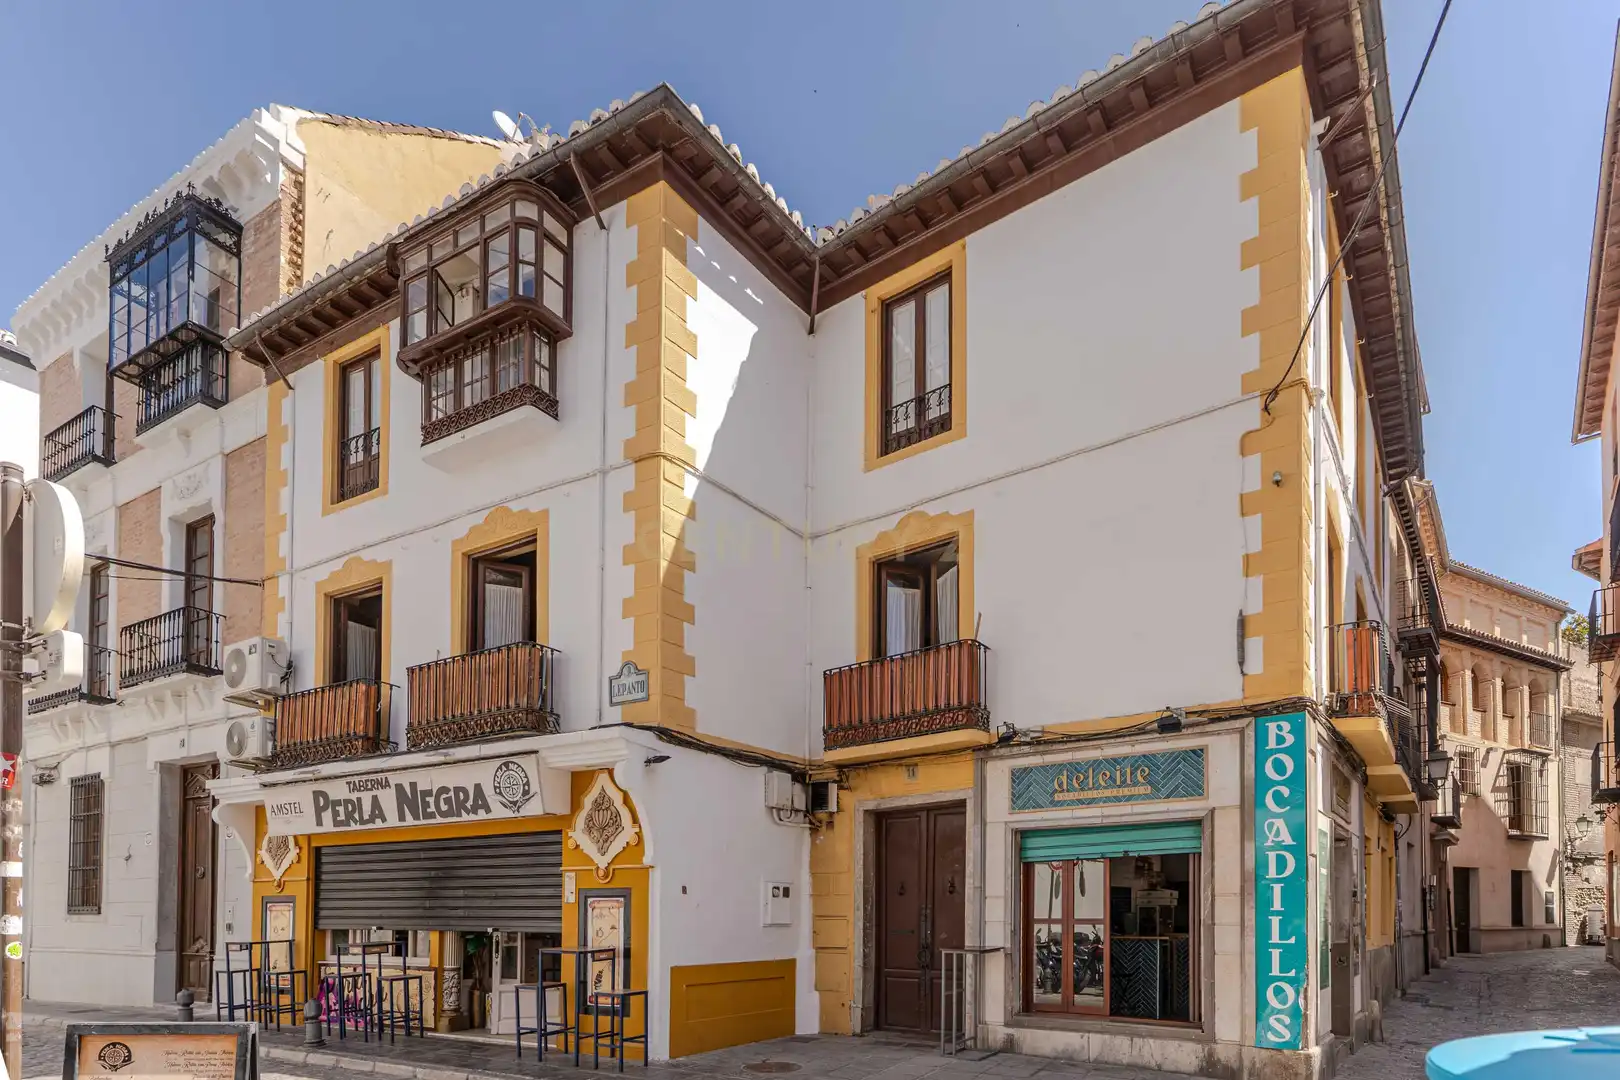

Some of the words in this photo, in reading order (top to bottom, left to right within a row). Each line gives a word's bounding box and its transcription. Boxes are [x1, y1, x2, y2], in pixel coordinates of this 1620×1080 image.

[612, 680, 645, 697] LEPANTO
[346, 776, 392, 795] TABERNA
[494, 764, 507, 787] PERLA
[508, 762, 528, 784] NEGRA
[1054, 765, 1150, 793] deleite
[270, 801, 304, 816] AMSTEL
[312, 789, 388, 828] PERLA
[394, 781, 493, 823] NEGRA
[1264, 721, 1296, 1042] BOCADILLOS
